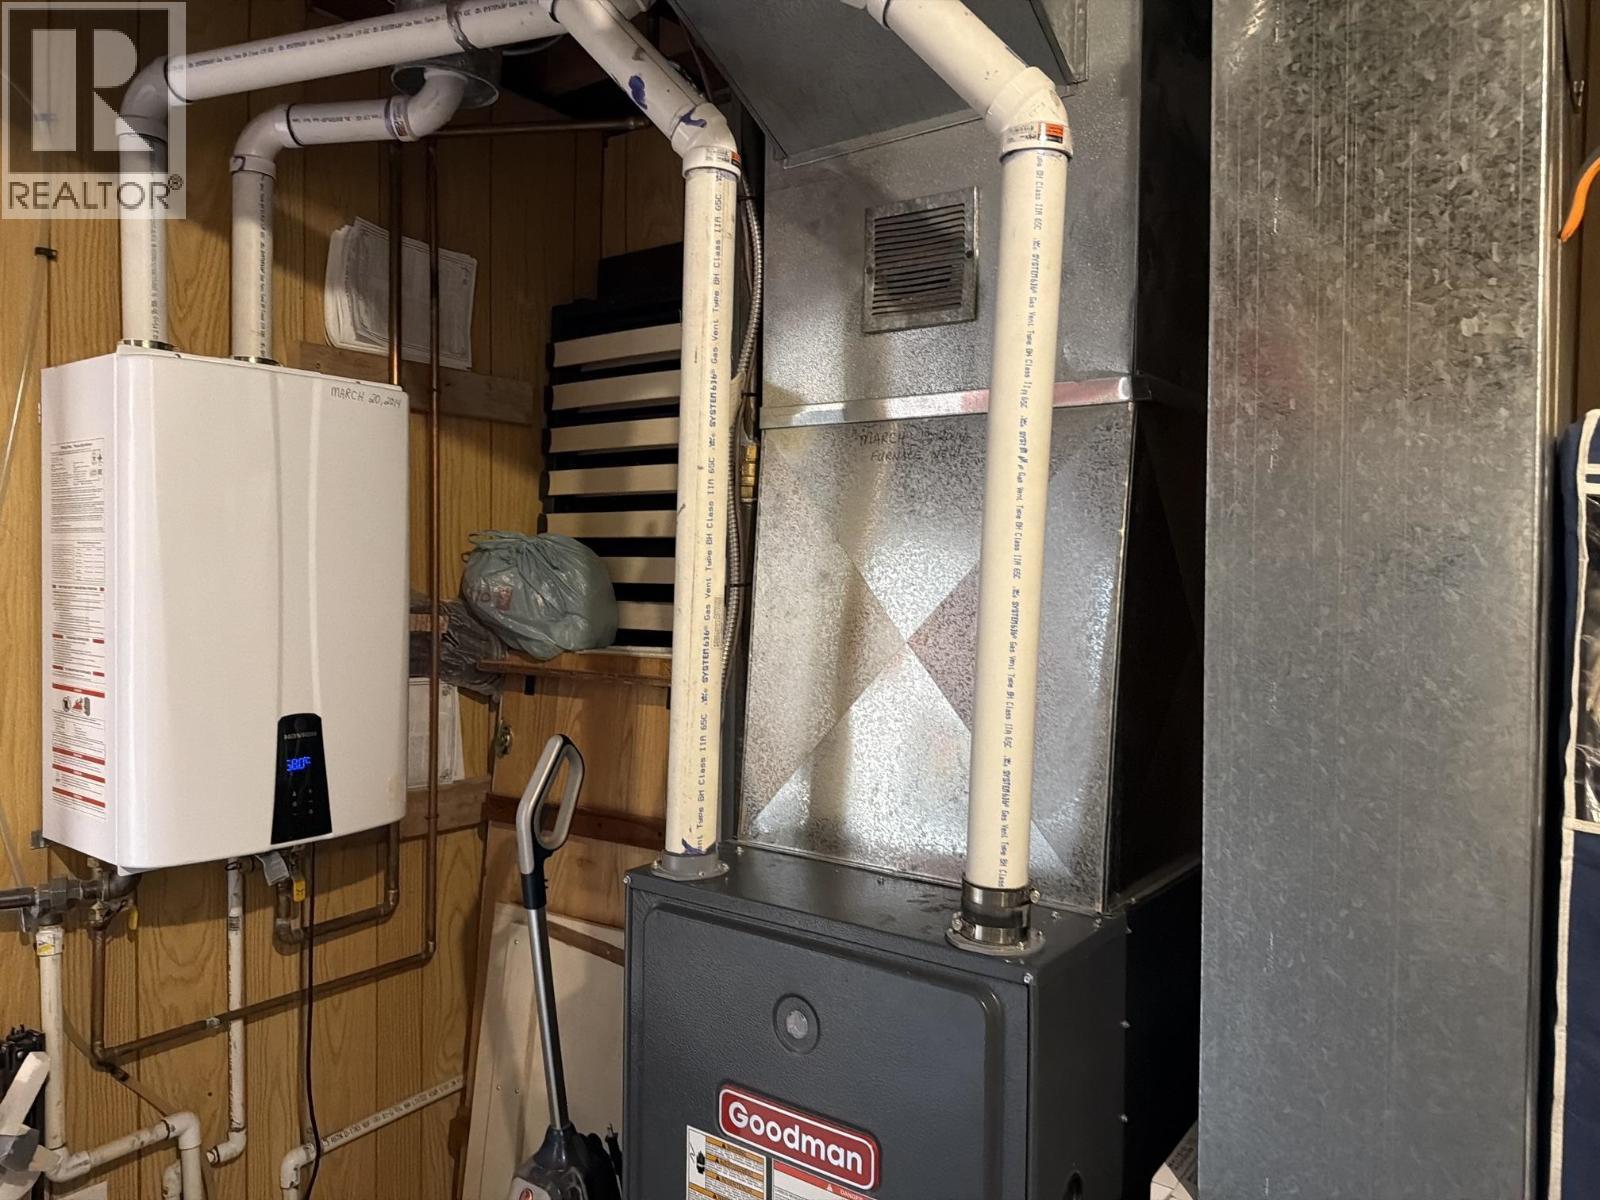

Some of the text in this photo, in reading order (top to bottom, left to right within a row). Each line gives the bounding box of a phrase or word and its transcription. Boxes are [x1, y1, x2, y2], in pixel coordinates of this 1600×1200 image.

[331, 386, 365, 401] MARCH
[1014, 532, 1022, 551] Class
[1005, 701, 1014, 719] Class
[728, 1101, 862, 1175] Goodman
